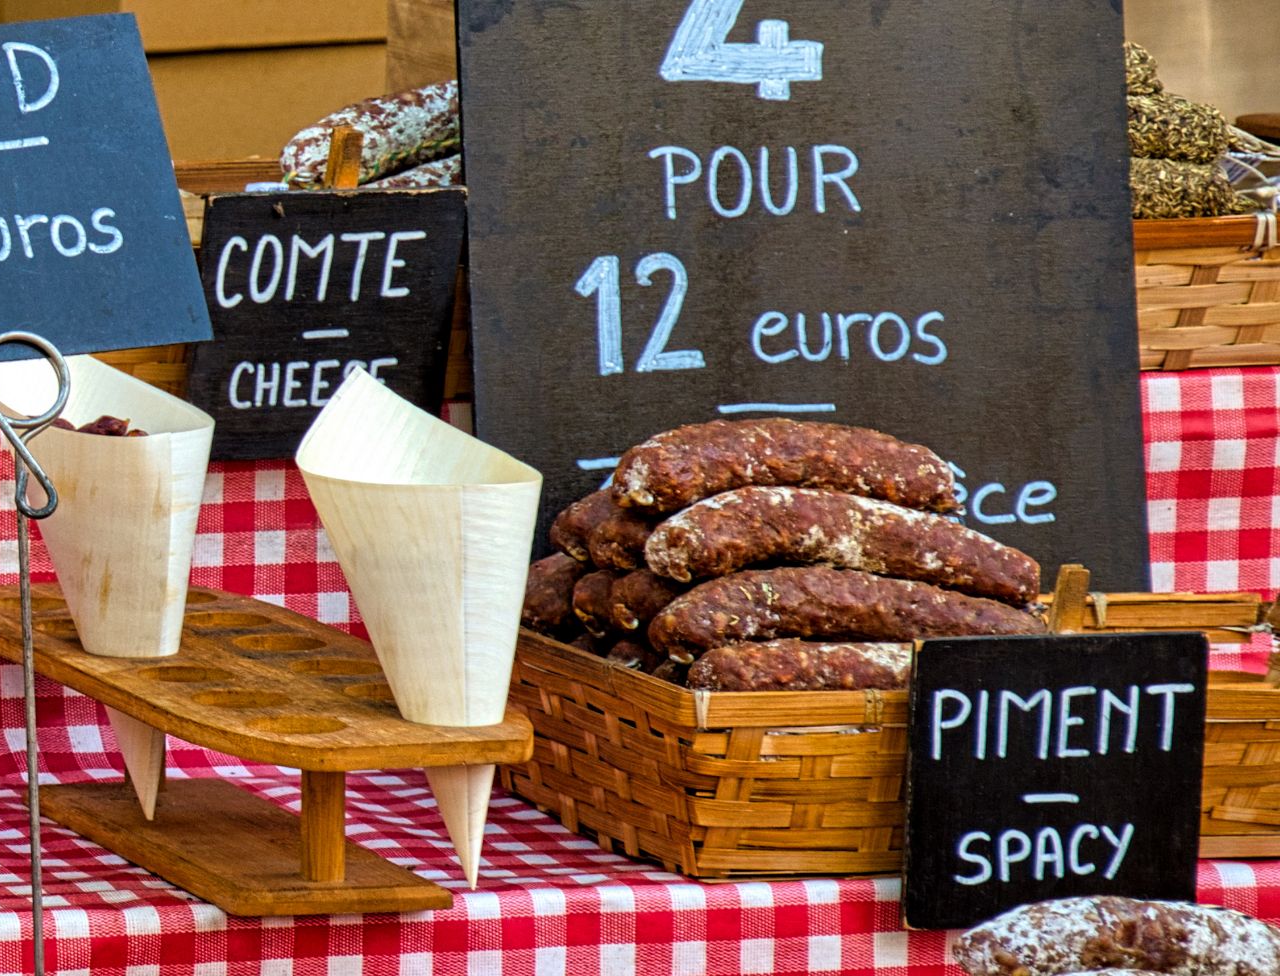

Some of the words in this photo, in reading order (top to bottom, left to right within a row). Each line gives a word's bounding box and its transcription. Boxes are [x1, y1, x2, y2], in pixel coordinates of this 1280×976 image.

[658, 0, 825, 101] 4
[647, 144, 862, 220] POUR
[215, 230, 428, 309] COMTE
[573, 252, 706, 377] 12
[751, 310, 949, 366] euros
[931, 683, 1196, 761] PIMENT
[953, 822, 1135, 886] SPACY
